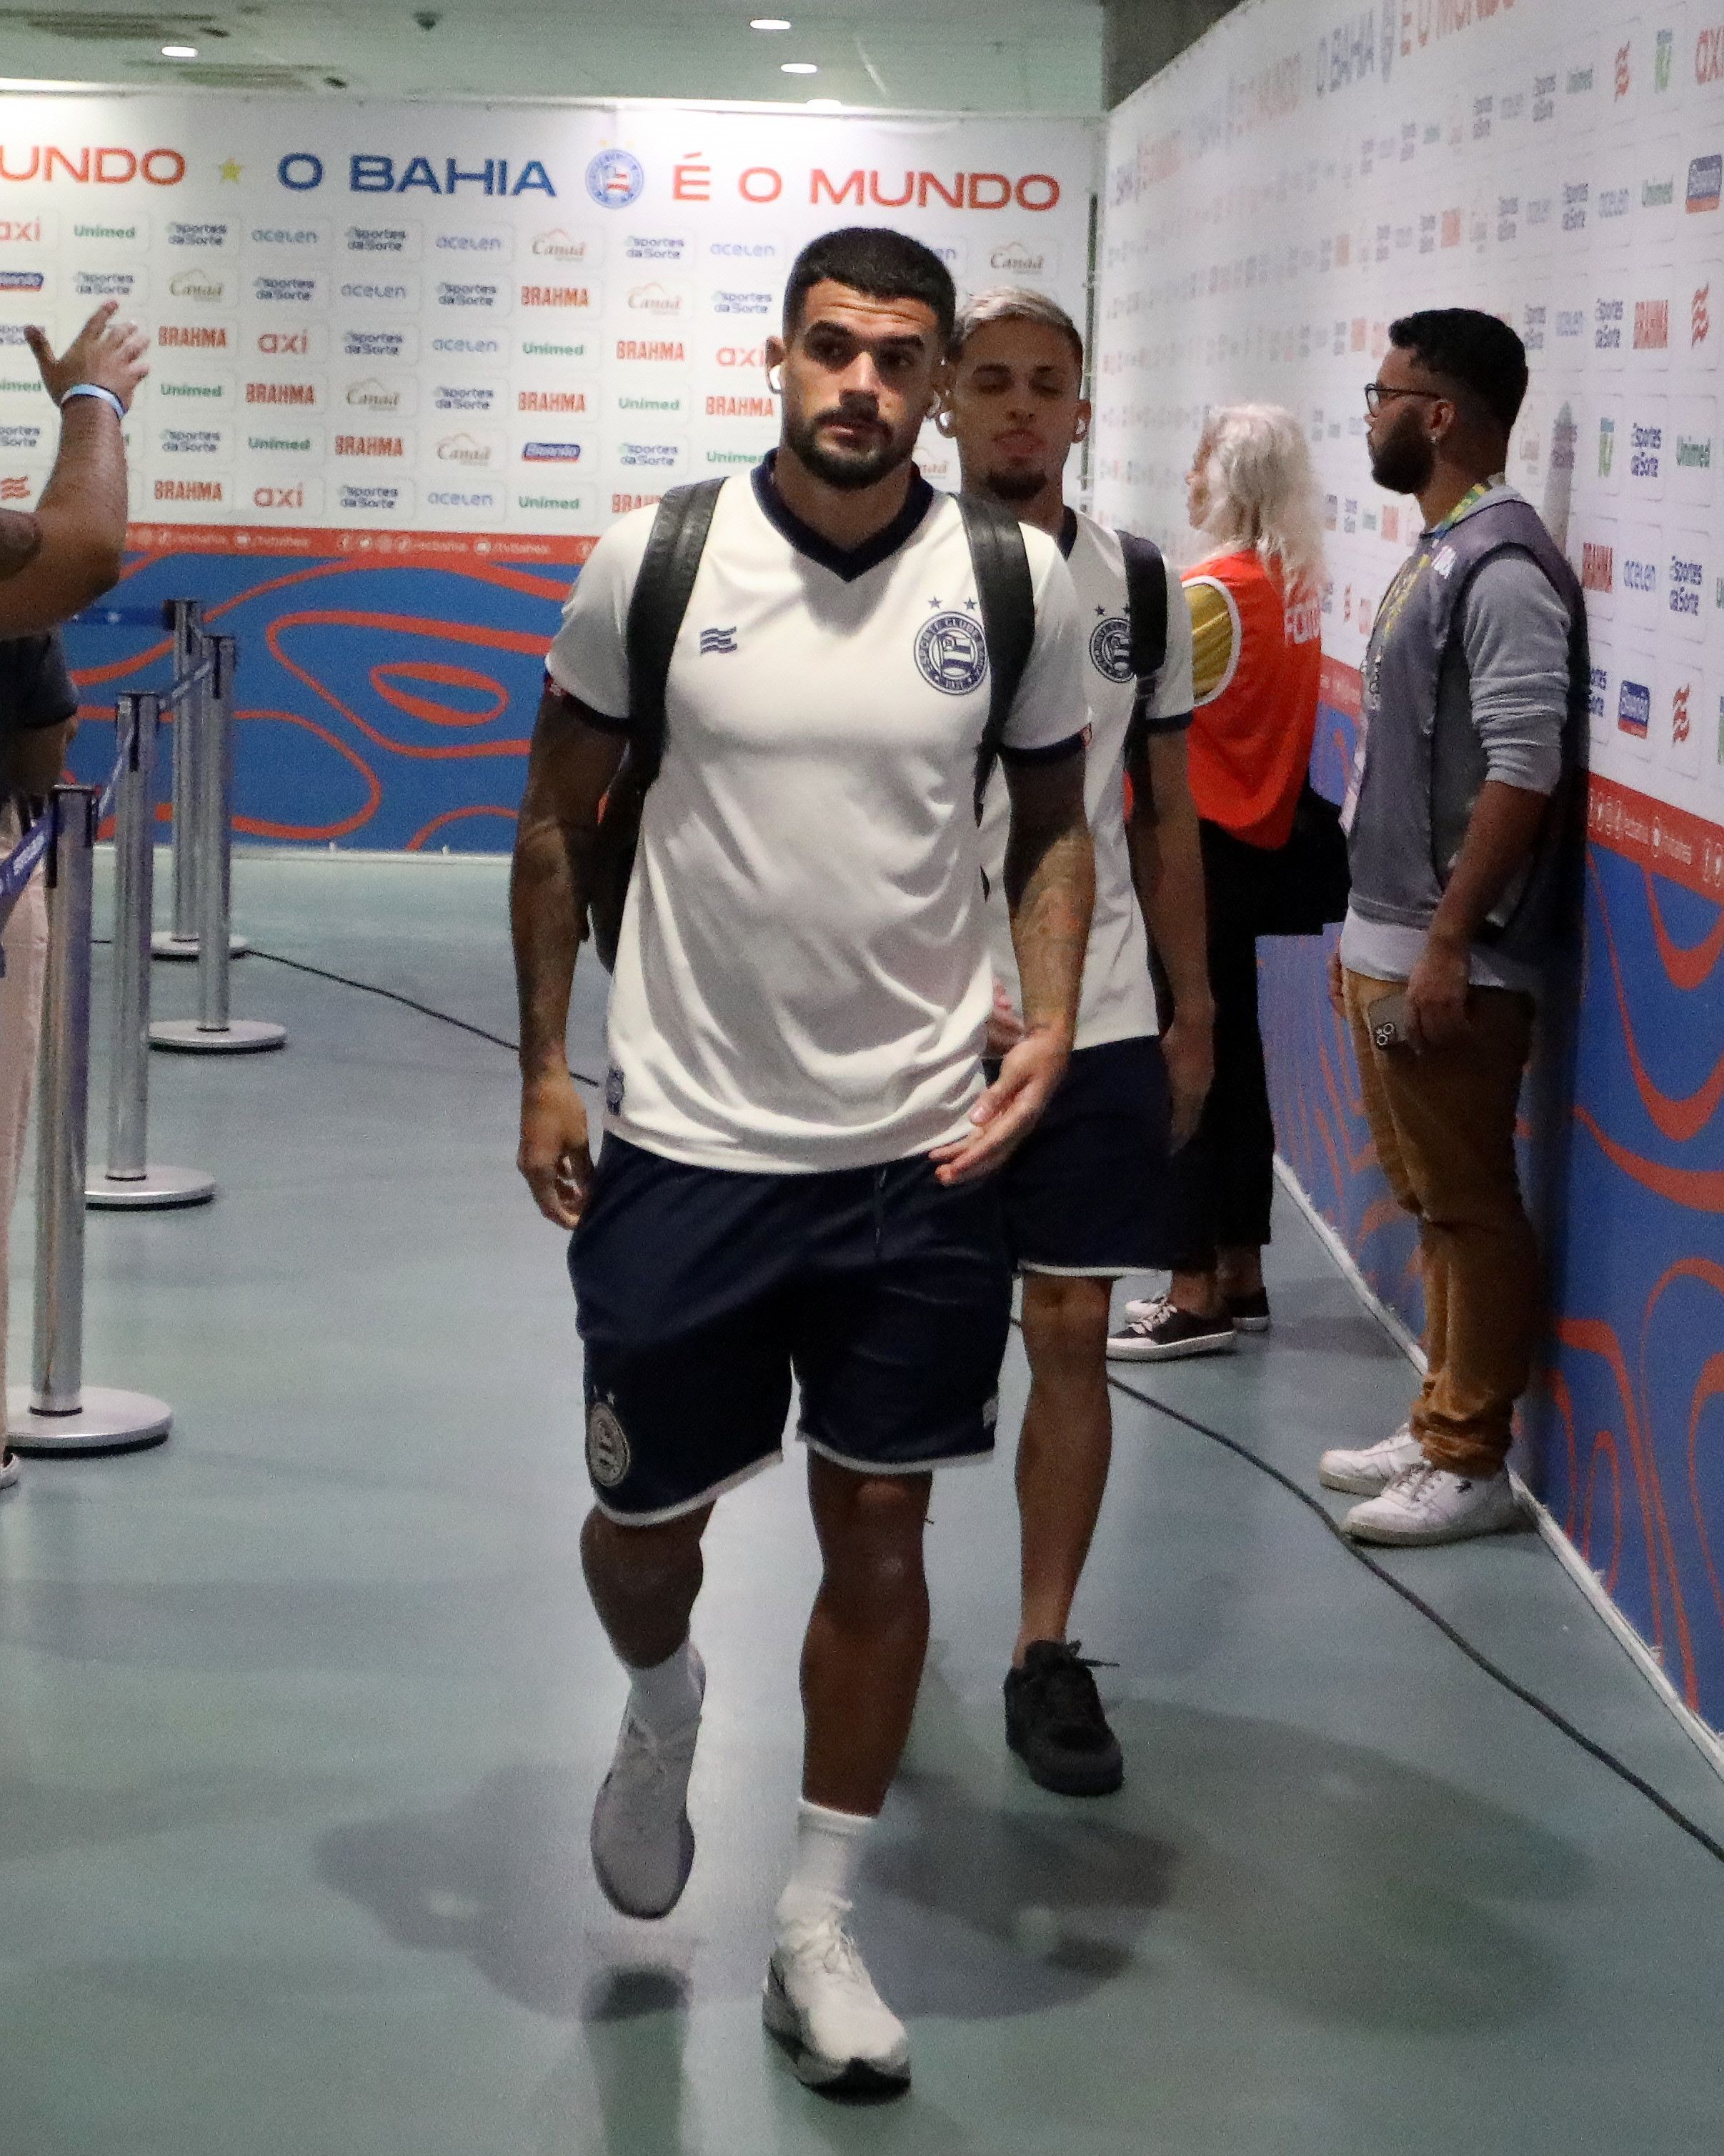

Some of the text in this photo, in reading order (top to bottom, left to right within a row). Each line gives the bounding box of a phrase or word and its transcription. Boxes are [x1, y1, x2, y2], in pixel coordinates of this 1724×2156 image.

[0, 146, 186, 186] UNDO
[277, 152, 325, 191] O
[349, 155, 557, 197] BAHIA
[673, 152, 710, 201] É
[738, 166, 782, 203] O
[809, 169, 1060, 211] MUNDO
[74, 223, 136, 239] Unimed
[709, 243, 775, 257] acelen
[521, 285, 589, 307] BRAHMA
[159, 326, 227, 347] BRAHMA
[258, 328, 307, 354] axi
[522, 341, 584, 356] Unimed
[617, 340, 685, 361] BRAHMA
[161, 383, 222, 397] Unimed
[246, 383, 315, 404] BRAHMA
[519, 391, 586, 412] BRAHMA
[619, 396, 680, 410] Unimed
[705, 395, 774, 416] BRAHMA
[336, 435, 403, 456] BRAHMA
[154, 479, 223, 501] BRAHMA
[254, 482, 303, 508] axi
[519, 493, 580, 509] Unimed
[612, 493, 662, 514] BRA
